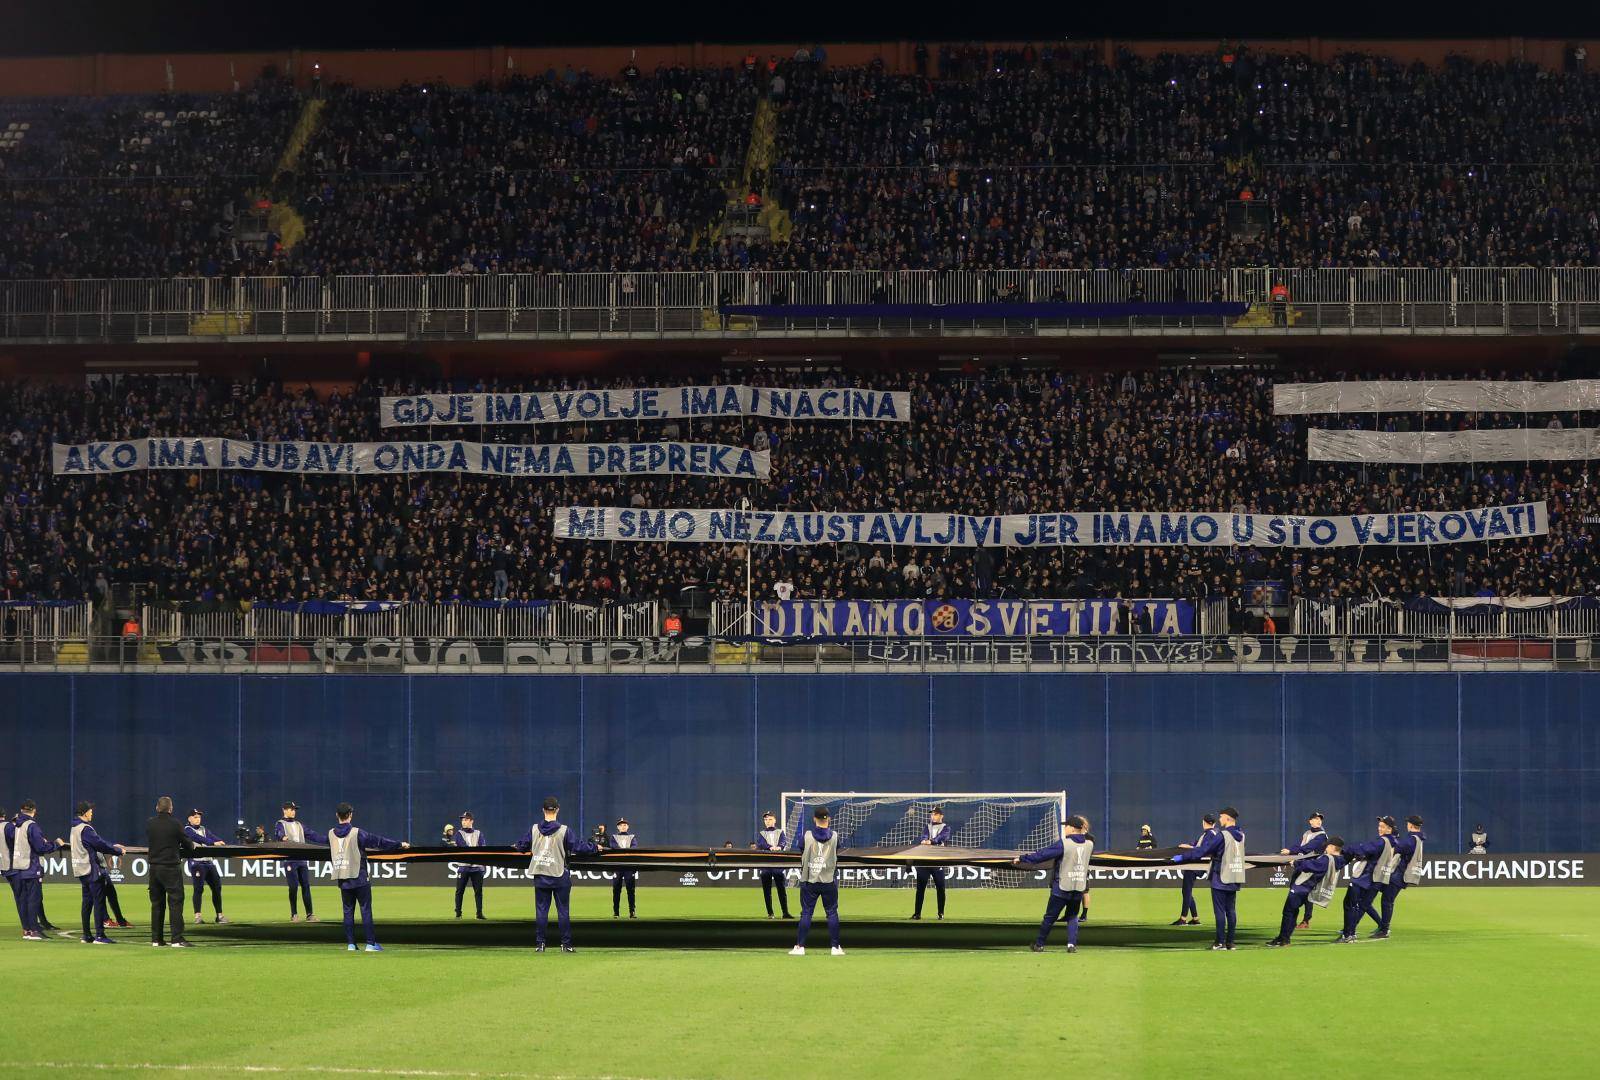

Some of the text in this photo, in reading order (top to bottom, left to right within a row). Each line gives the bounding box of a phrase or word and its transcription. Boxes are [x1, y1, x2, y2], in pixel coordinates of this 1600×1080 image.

[392, 394, 474, 423] GDJE
[486, 394, 544, 422] IMA
[552, 390, 668, 420] VOLJE,
[681, 386, 743, 415] IMA
[750, 388, 760, 413] I
[64, 439, 756, 476] AKO IMA LJUBAVI, ONDA NEMA PREPREKA
[568, 508, 605, 538] MI
[618, 510, 696, 540] SMO
[709, 511, 1001, 545] NEZAUSTAVLJIVI
[1014, 514, 1078, 545] JER
[1093, 514, 1219, 544] IMAMO
[1232, 513, 1254, 542] U
[1352, 506, 1536, 544] VJEROVATI
[761, 601, 925, 636] DINAMO
[1420, 859, 1585, 880] MERCHANDISE
